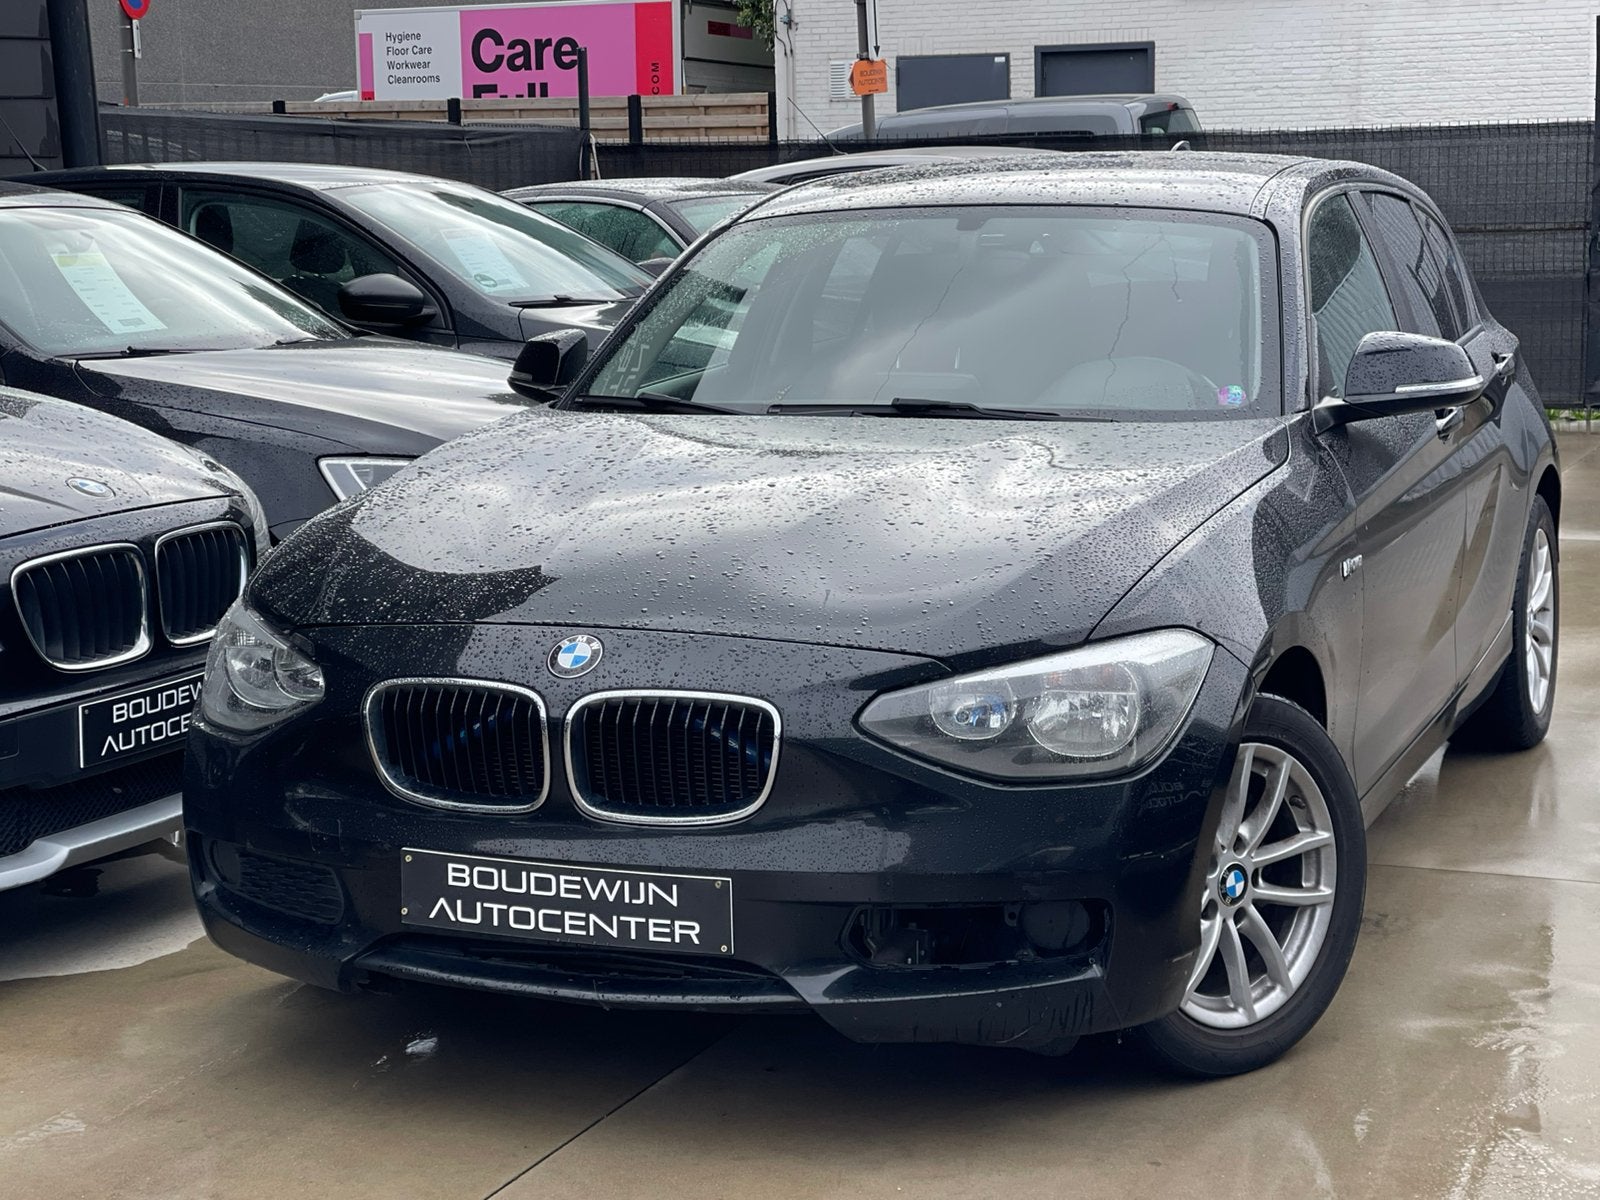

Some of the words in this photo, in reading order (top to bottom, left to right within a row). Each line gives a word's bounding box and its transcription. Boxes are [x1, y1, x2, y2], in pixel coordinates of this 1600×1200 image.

[385, 32, 421, 43] Hygiene
[386, 46, 409, 56] Floor
[411, 45, 432, 55] Care
[471, 28, 579, 73] Care
[387, 60, 431, 70] Workwear
[387, 74, 440, 84] Cleanrooms
[447, 862, 678, 907] BOUDEWIJN
[428, 897, 701, 944] AUTOCENTER
